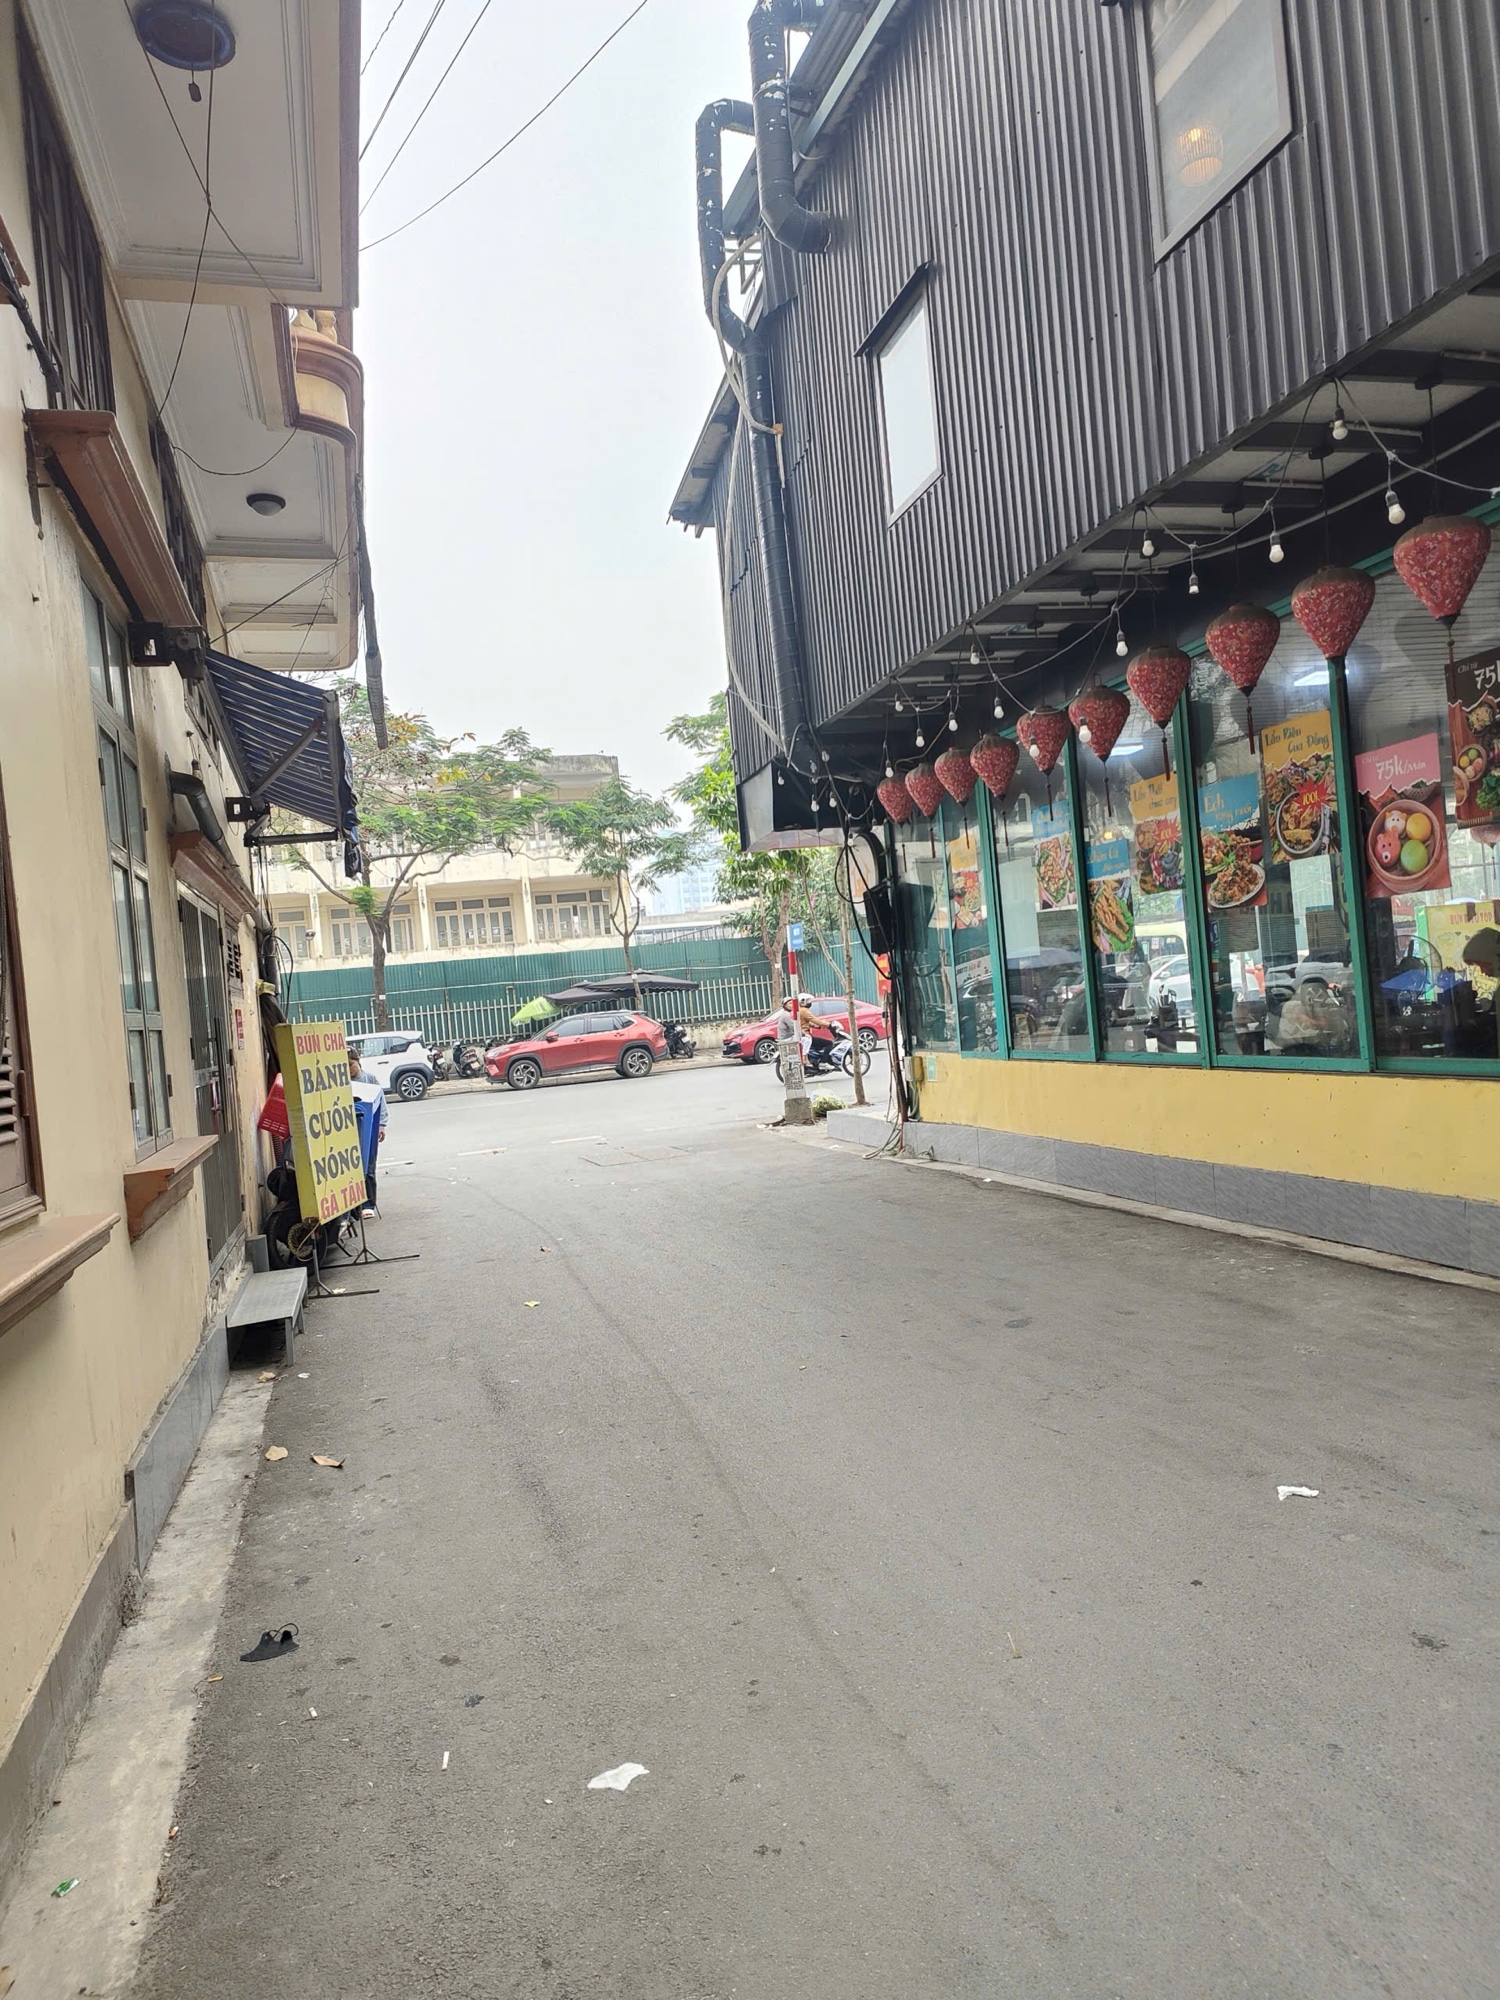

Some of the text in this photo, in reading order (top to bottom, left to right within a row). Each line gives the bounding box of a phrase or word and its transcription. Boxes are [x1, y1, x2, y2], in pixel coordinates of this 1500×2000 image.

[1287, 741, 1303, 753] Cua
[295, 1026, 346, 1056] BÚN CHẢ
[301, 1059, 350, 1094] BÁNH
[309, 1096, 355, 1139] CUỐN
[313, 1145, 361, 1185] NÓNG
[320, 1177, 365, 1220] GÀ TẦN
